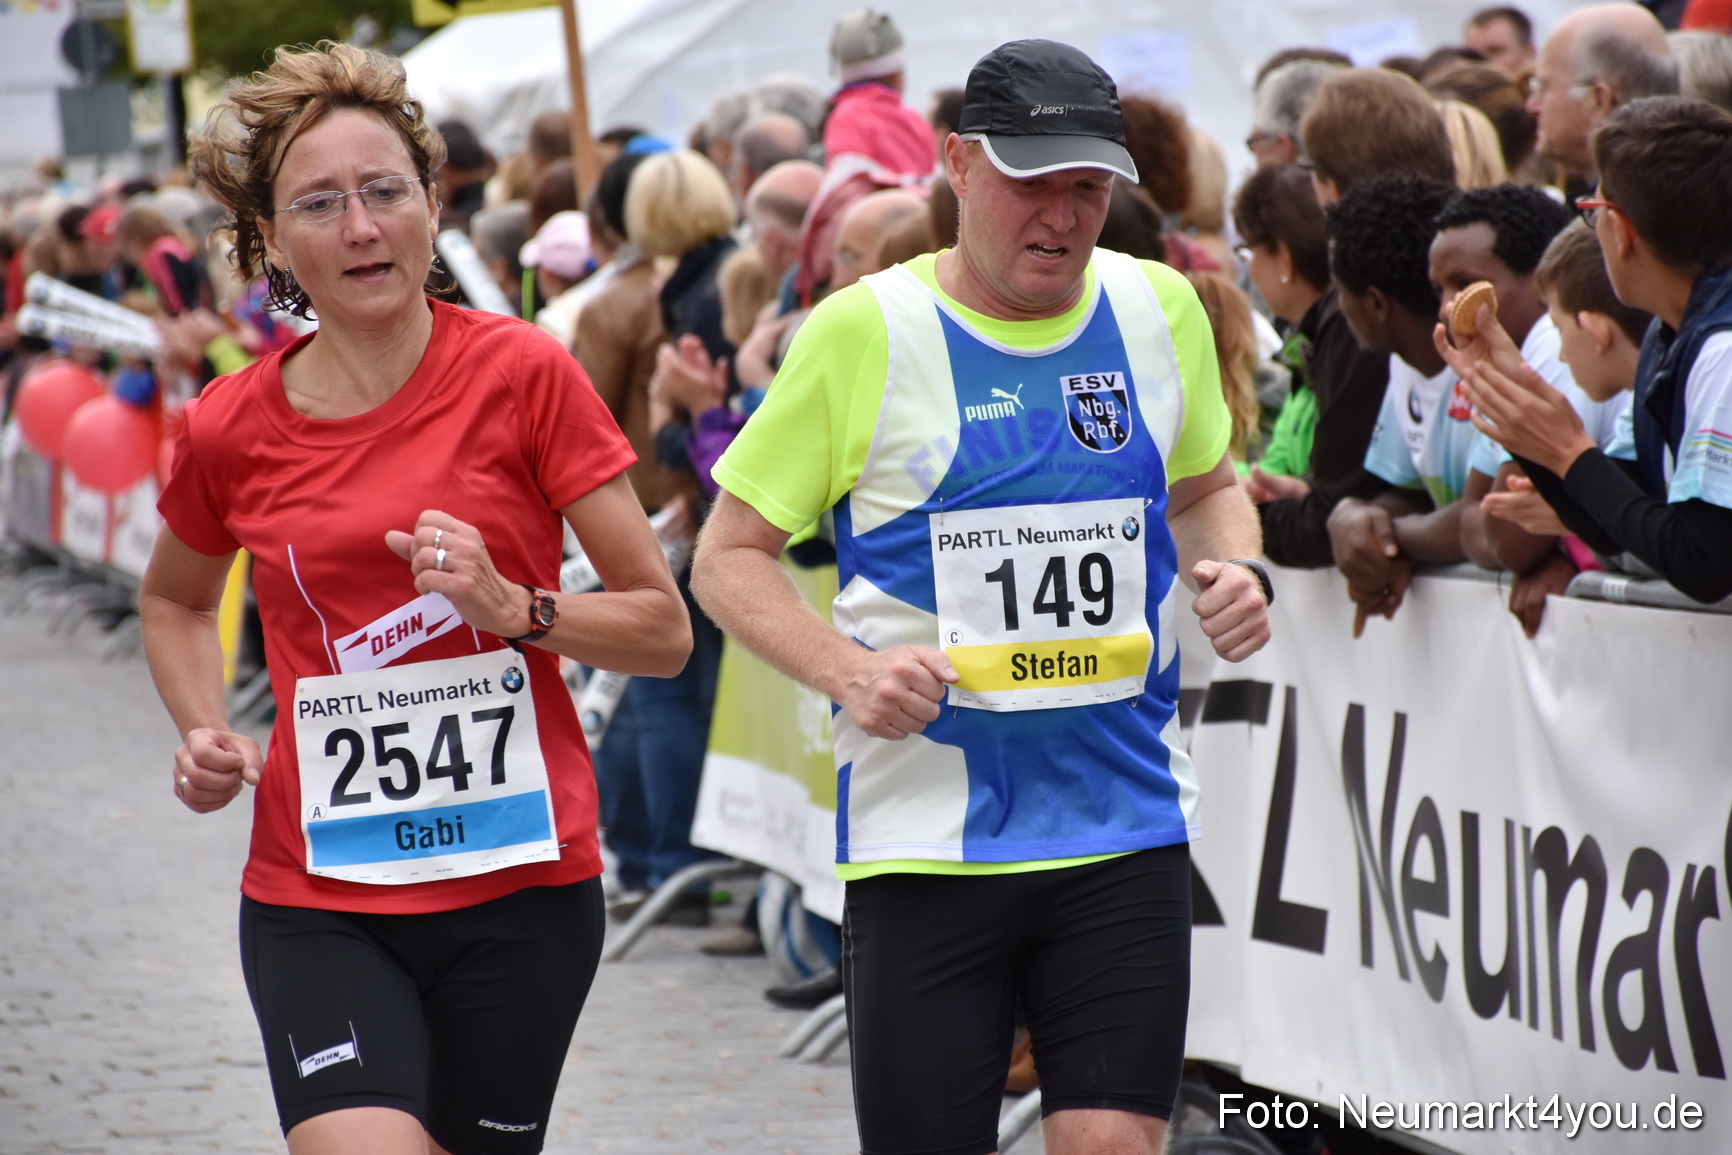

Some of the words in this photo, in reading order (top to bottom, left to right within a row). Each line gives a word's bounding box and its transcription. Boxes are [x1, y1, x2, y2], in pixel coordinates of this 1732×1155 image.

[1040, 105, 1065, 115] asics
[1068, 374, 1117, 392] ESV
[965, 401, 1016, 423] PUMA
[1078, 398, 1122, 418] Nbg.
[1082, 419, 1125, 441] Rbf.
[938, 529, 1012, 552] PARTL
[1017, 522, 1116, 546] Neumarkt
[984, 552, 1115, 631] 149
[371, 612, 423, 657] DEHN
[950, 631, 959, 645] C
[1011, 650, 1098, 682] Stefan
[299, 694, 373, 720] PARTL
[377, 677, 493, 711] Neumarkt
[324, 705, 515, 808] 2547
[312, 805, 322, 819] A
[394, 815, 466, 851] Gabi
[1341, 702, 1732, 1080] Neumar
[314, 1051, 340, 1066] DEHN
[478, 1118, 538, 1133] BROOKS
